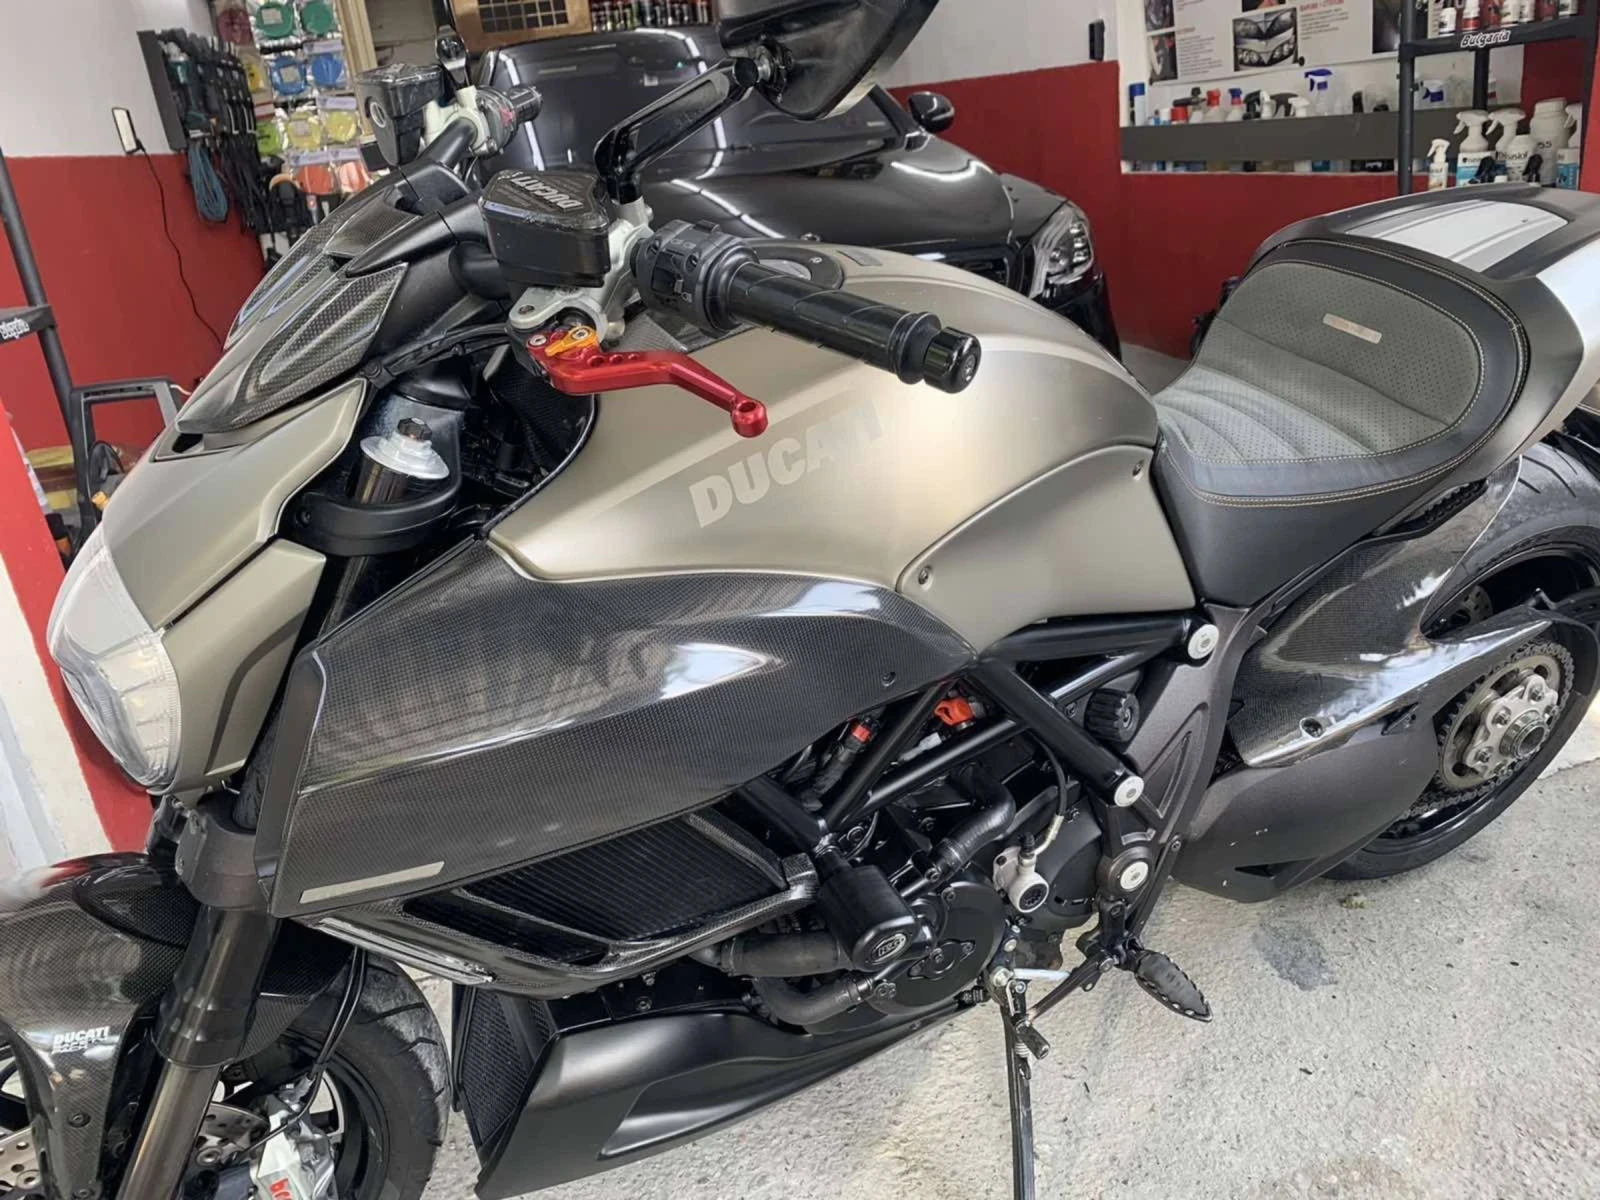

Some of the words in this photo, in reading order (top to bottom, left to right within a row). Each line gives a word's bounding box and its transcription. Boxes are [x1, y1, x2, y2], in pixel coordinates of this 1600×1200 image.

[1460, 29, 1512, 48] Bulgaria
[510, 175, 584, 209] DUCATI
[688, 399, 883, 528] DUCATI
[53, 1025, 110, 1044] DUCATI
